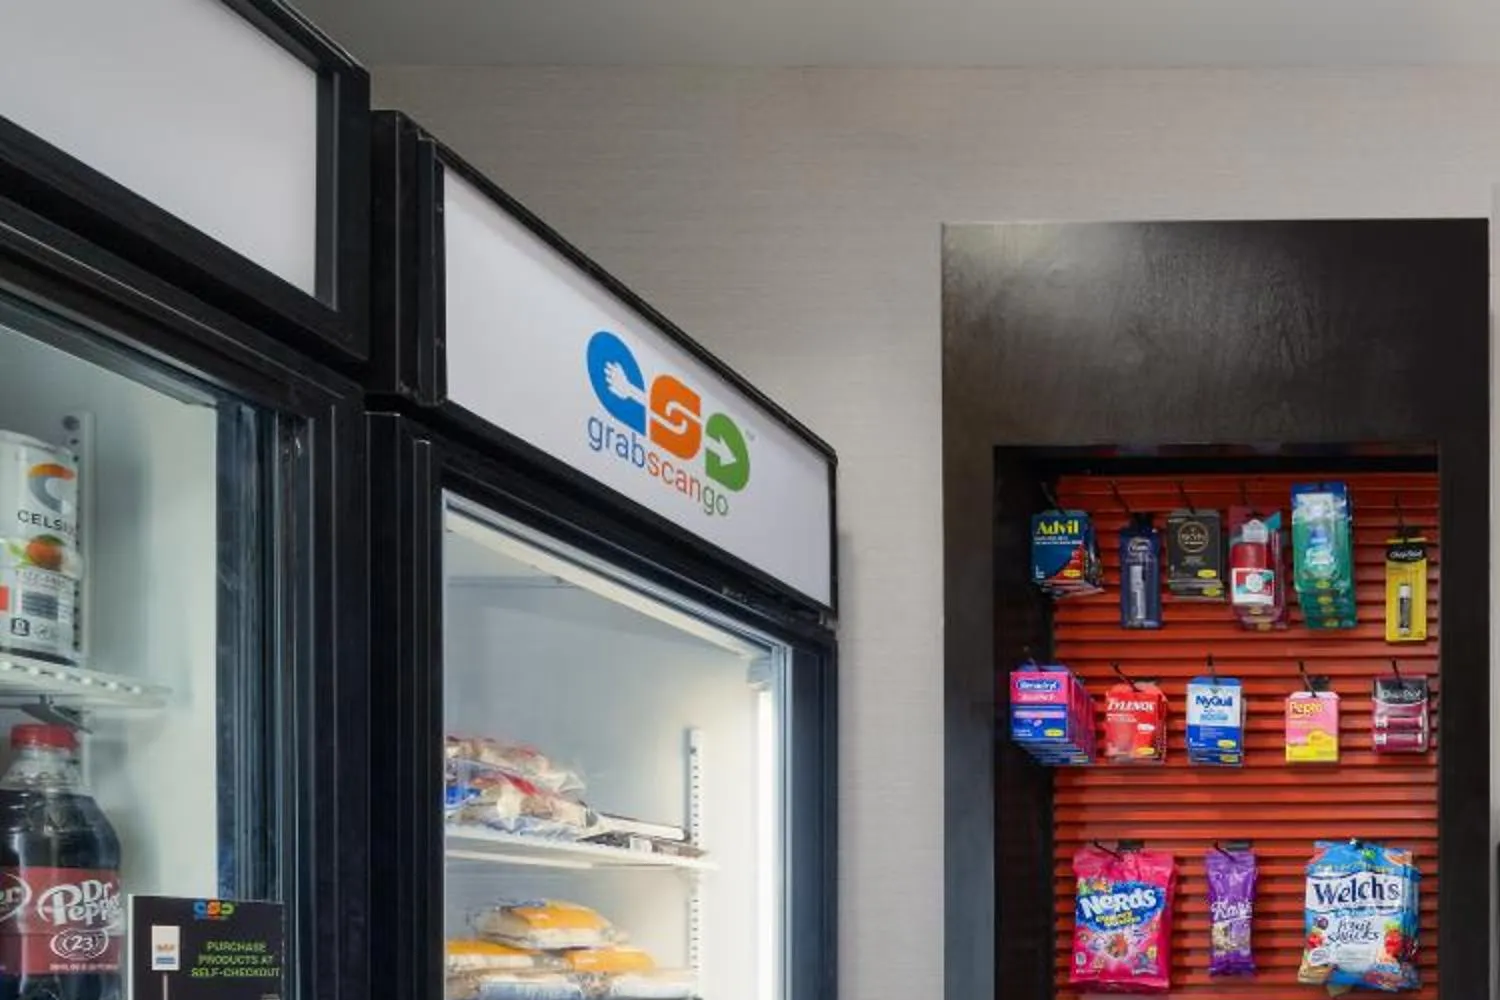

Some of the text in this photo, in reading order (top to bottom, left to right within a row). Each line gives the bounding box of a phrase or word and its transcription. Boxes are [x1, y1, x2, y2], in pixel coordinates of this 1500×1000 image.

[587, 415, 729, 517] grabscango
[17, 508, 78, 537] CELSI
[1037, 519, 1080, 536] Advil
[82, 879, 113, 901] Dr
[1313, 875, 1401, 905] Welch's
[71, 935, 95, 951] 23
[206, 941, 267, 952] PURCHASE
[198, 954, 274, 965] PRODUCTS AT
[191, 967, 281, 978] SELF-CHECKOUT
